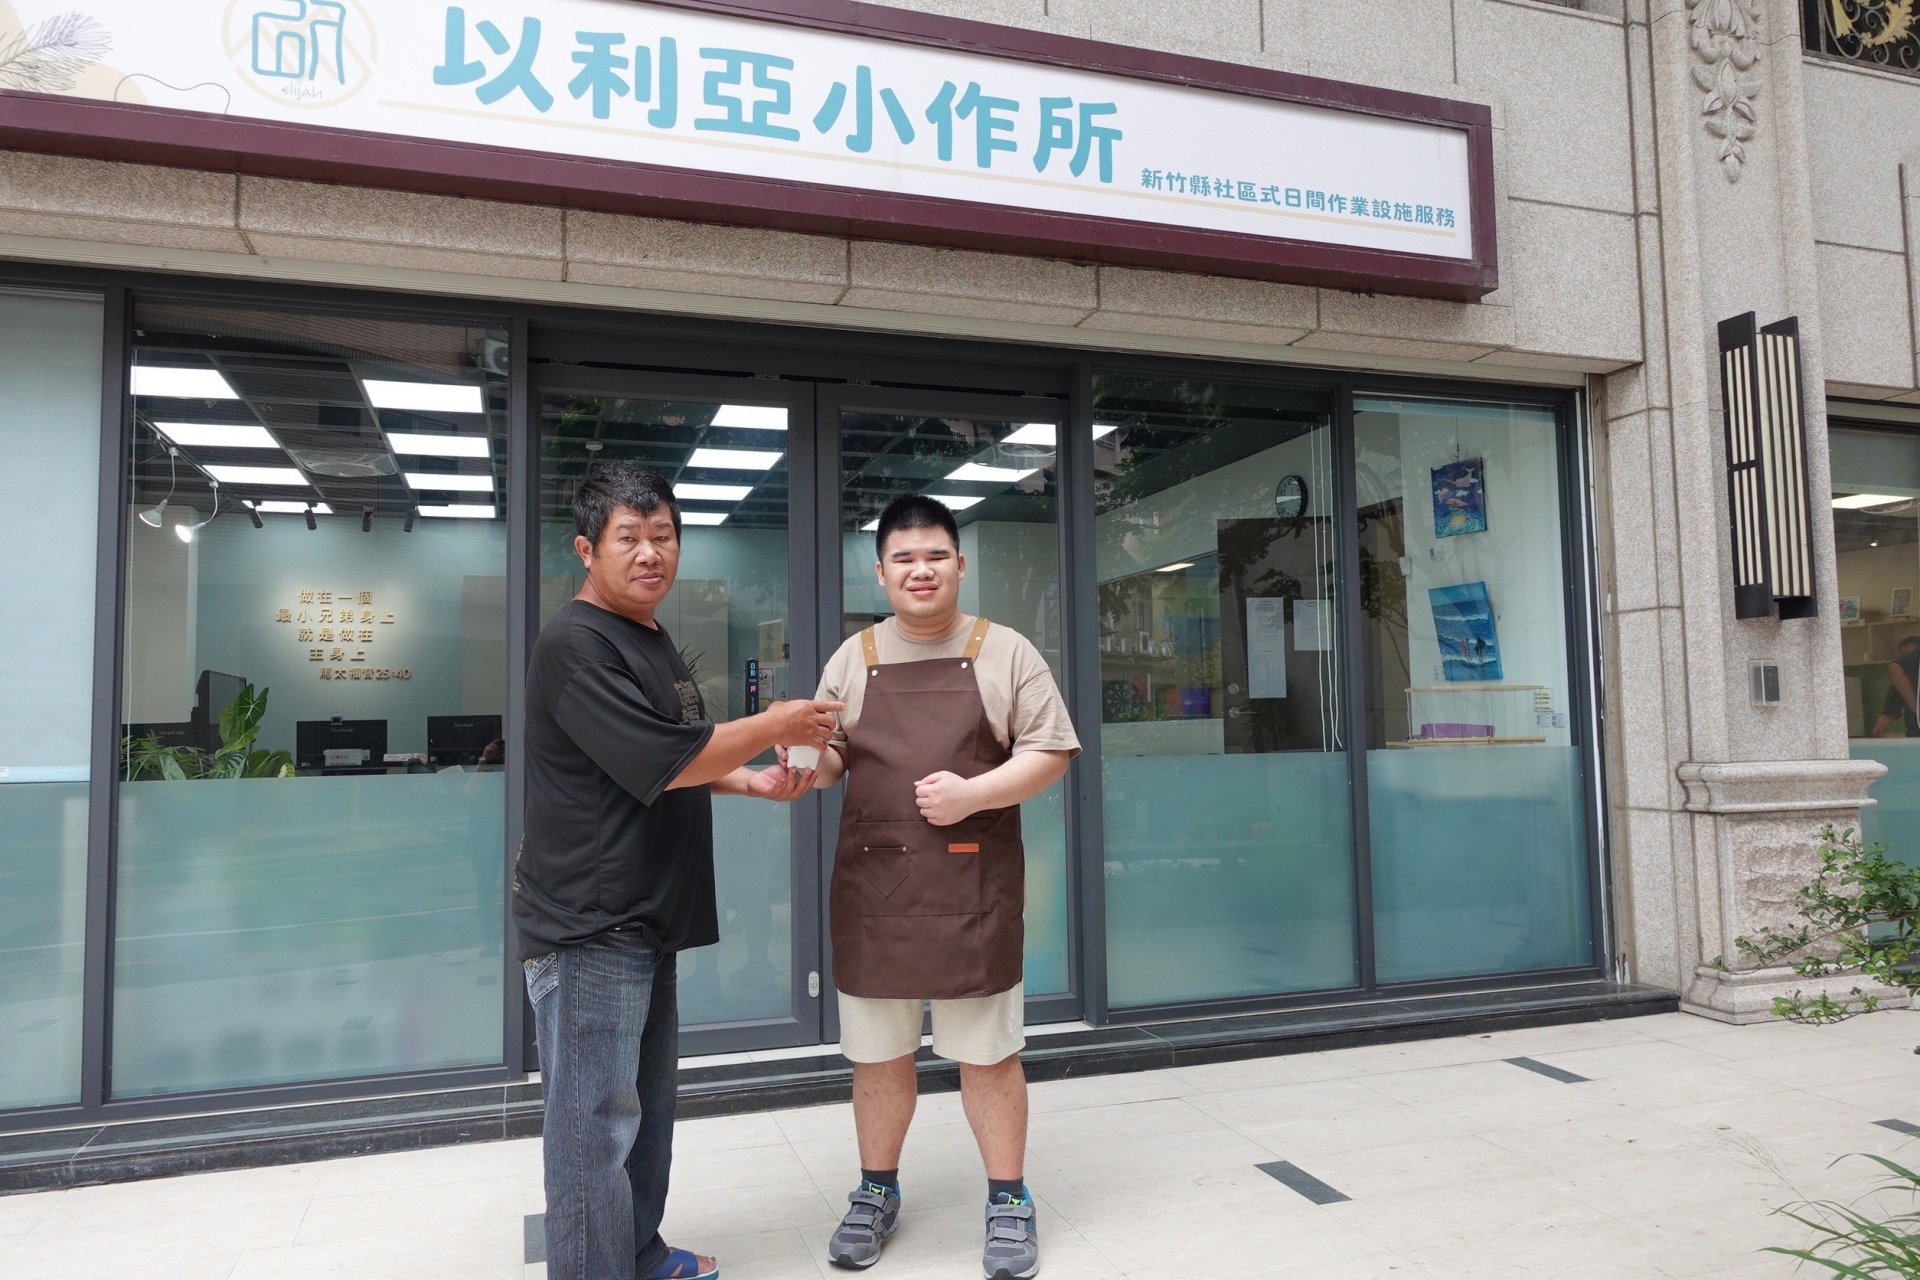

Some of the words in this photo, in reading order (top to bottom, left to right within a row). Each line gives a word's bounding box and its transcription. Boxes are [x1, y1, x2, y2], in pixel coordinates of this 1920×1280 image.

[281, 83, 323, 101] elijah
[433, 6, 1123, 185] 以利亞小作所
[1141, 167, 1456, 228] 新竹縣社區式日間作業設施服務
[298, 589, 373, 605] 做在一個
[276, 608, 395, 624] 最小兄弟身上
[297, 628, 373, 643] 就是做在
[309, 647, 365, 662] 主身上
